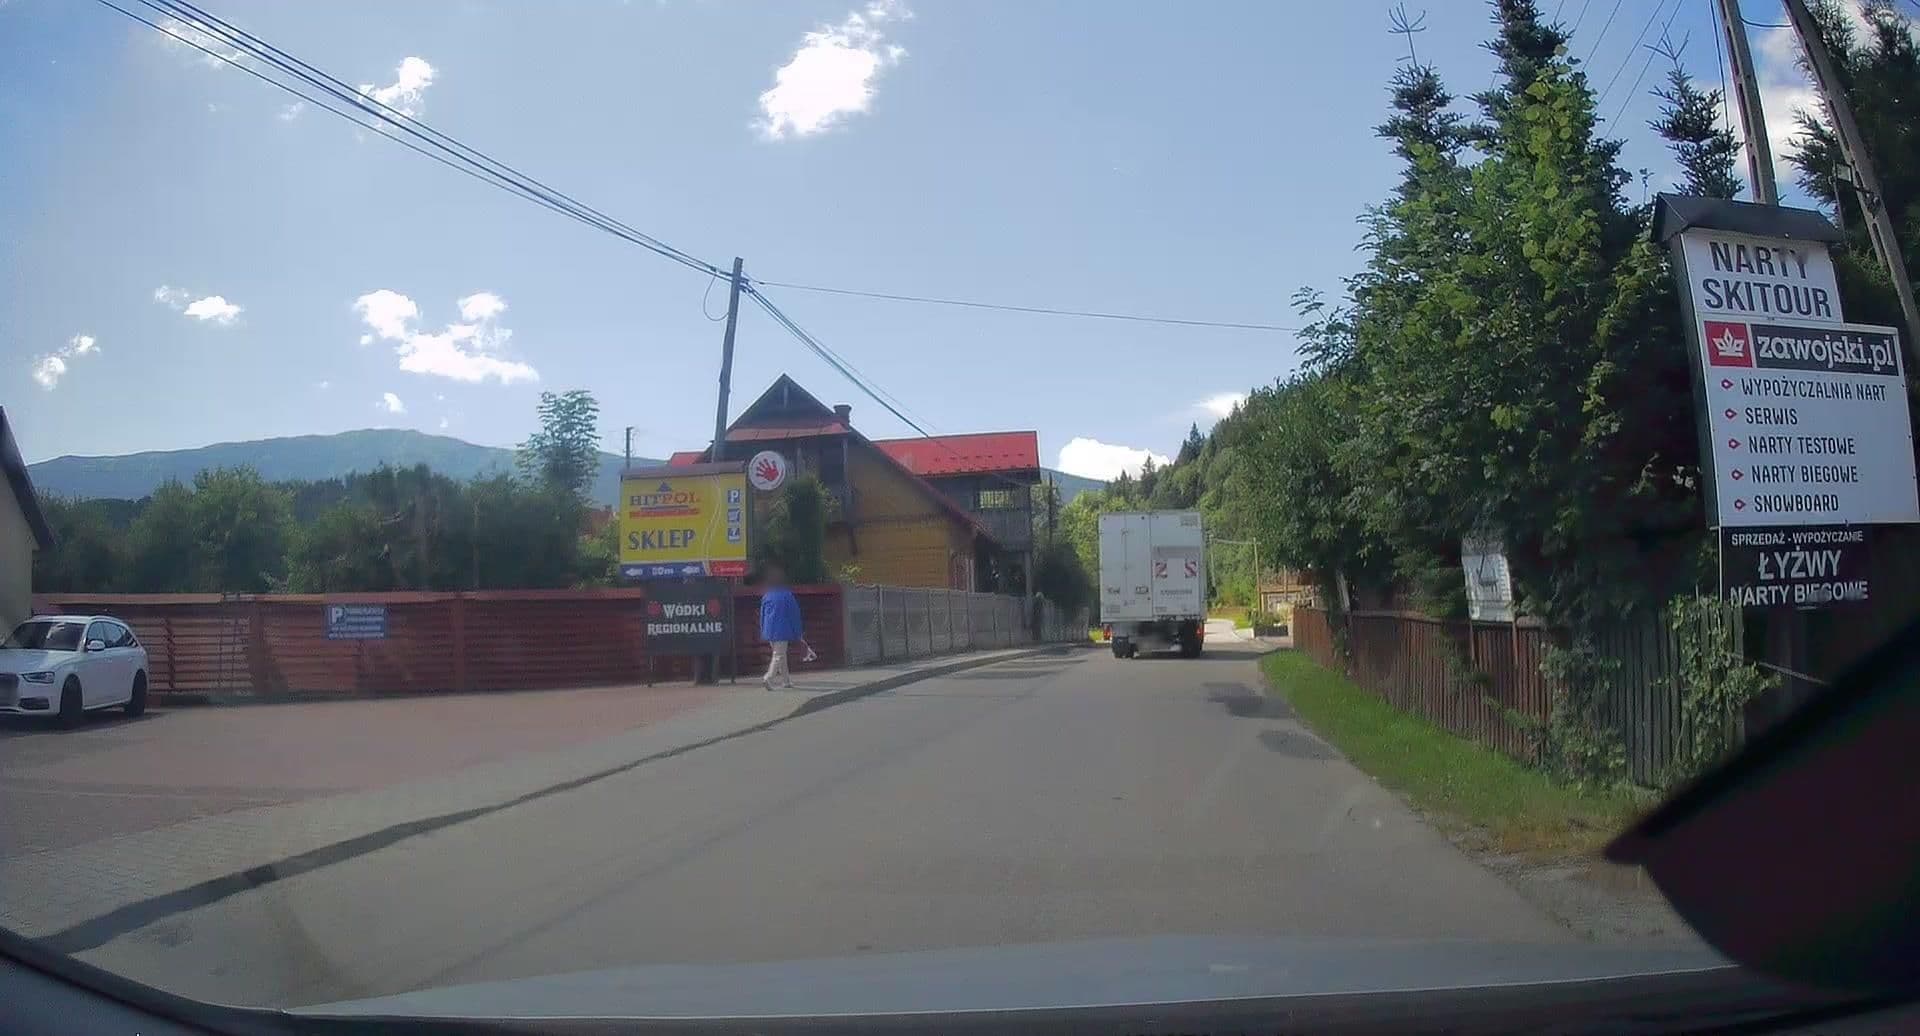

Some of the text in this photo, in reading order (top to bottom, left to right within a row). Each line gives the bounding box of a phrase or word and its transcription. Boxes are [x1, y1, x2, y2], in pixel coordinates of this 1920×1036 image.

[1709, 241, 1809, 279] NARTY
[1703, 278, 1832, 318] SKITOUR
[1757, 333, 1895, 371] zawojski.pl
[1742, 375, 1886, 401] WYPOŻYCZALNIA NART
[1745, 407, 1798, 425] SERWIS
[1749, 436, 1856, 455] NARTY TESTOWE
[1752, 465, 1858, 483] NARTY BIEGOWE
[1754, 494, 1839, 513] SNOWBOARD
[628, 529, 696, 550] SKLEP
[1731, 530, 1785, 546] SPRZEDAŻ
[1793, 530, 1863, 544] WYPOŻYCZANIE
[1758, 545, 1842, 580] ŁYŻWY
[1730, 580, 1869, 609] NARTY BIEGOWE
[662, 603, 705, 618] WÓDKI
[647, 622, 722, 636] REGIONALNE
